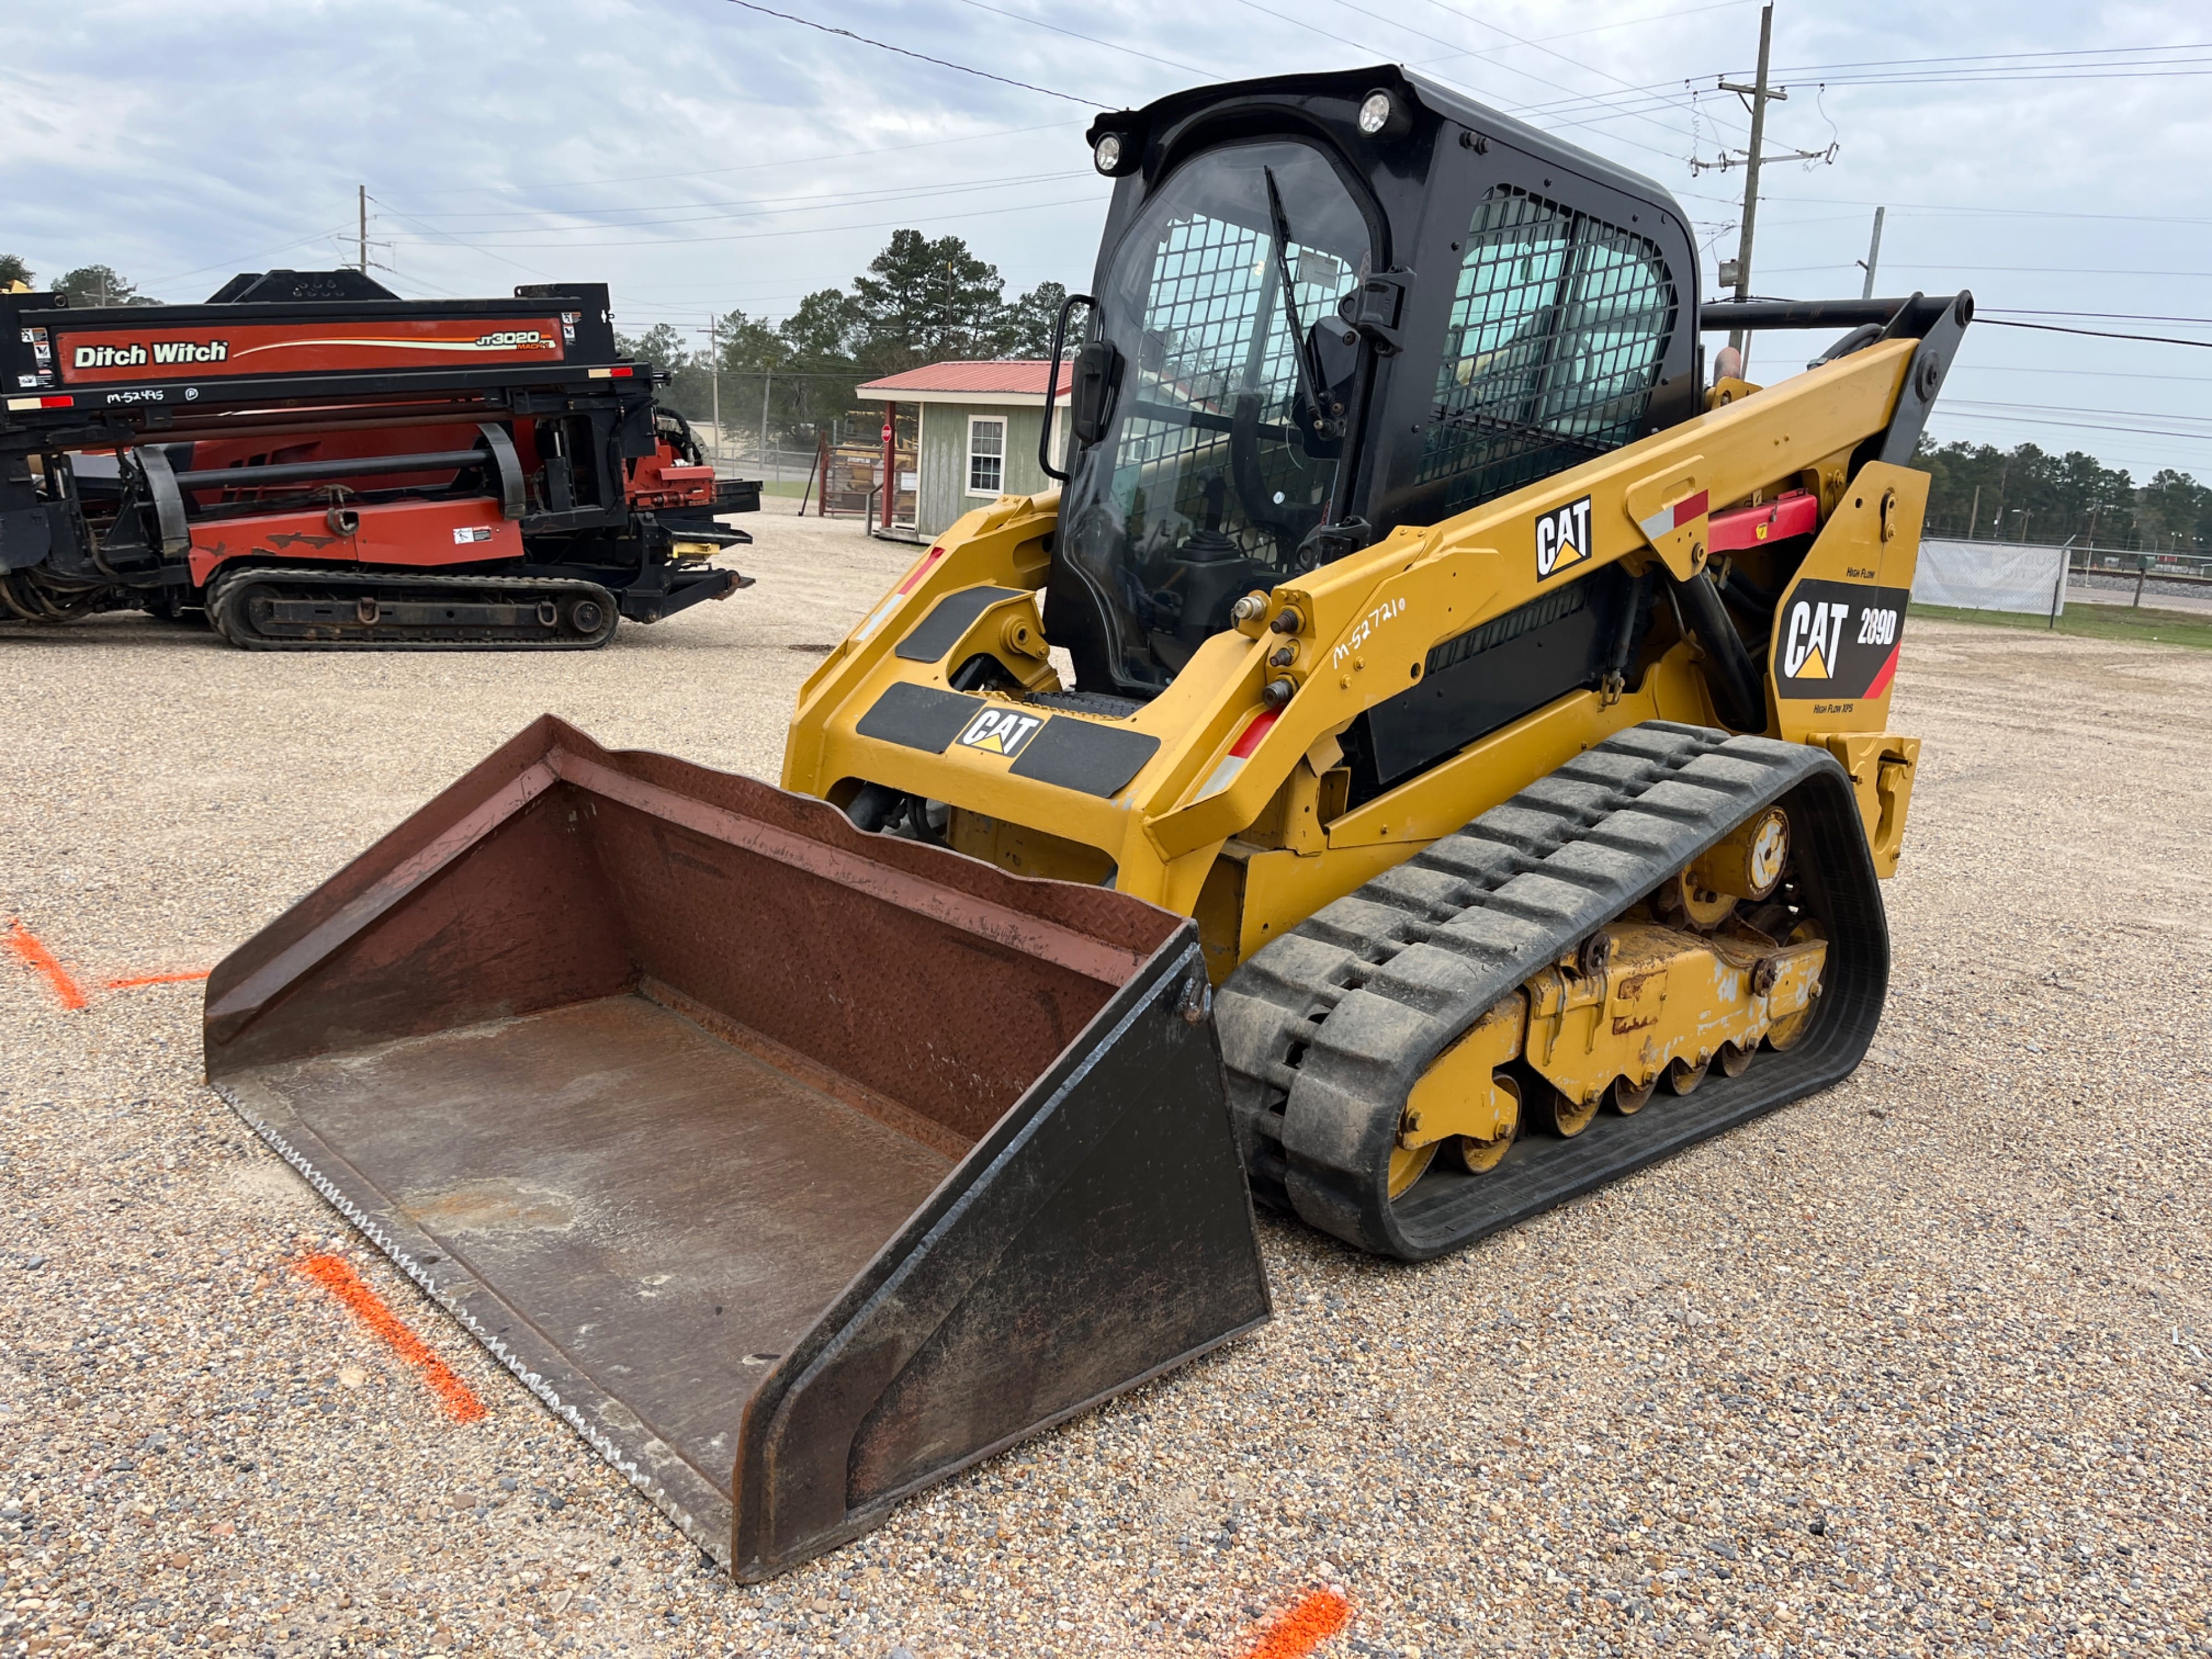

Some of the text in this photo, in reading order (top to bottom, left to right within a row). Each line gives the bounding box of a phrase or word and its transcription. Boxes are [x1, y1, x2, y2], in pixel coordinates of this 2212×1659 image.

[75, 345, 147, 367] Ditch
[153, 342, 226, 363] Witch
[477, 332, 540, 345] JT3020
[1537, 499, 1590, 575] CAT
[1333, 597, 1405, 670] M-527210
[1784, 601, 1897, 679] CAT 289D
[1841, 703, 1854, 713] XPS
[963, 710, 1040, 754] CAT
